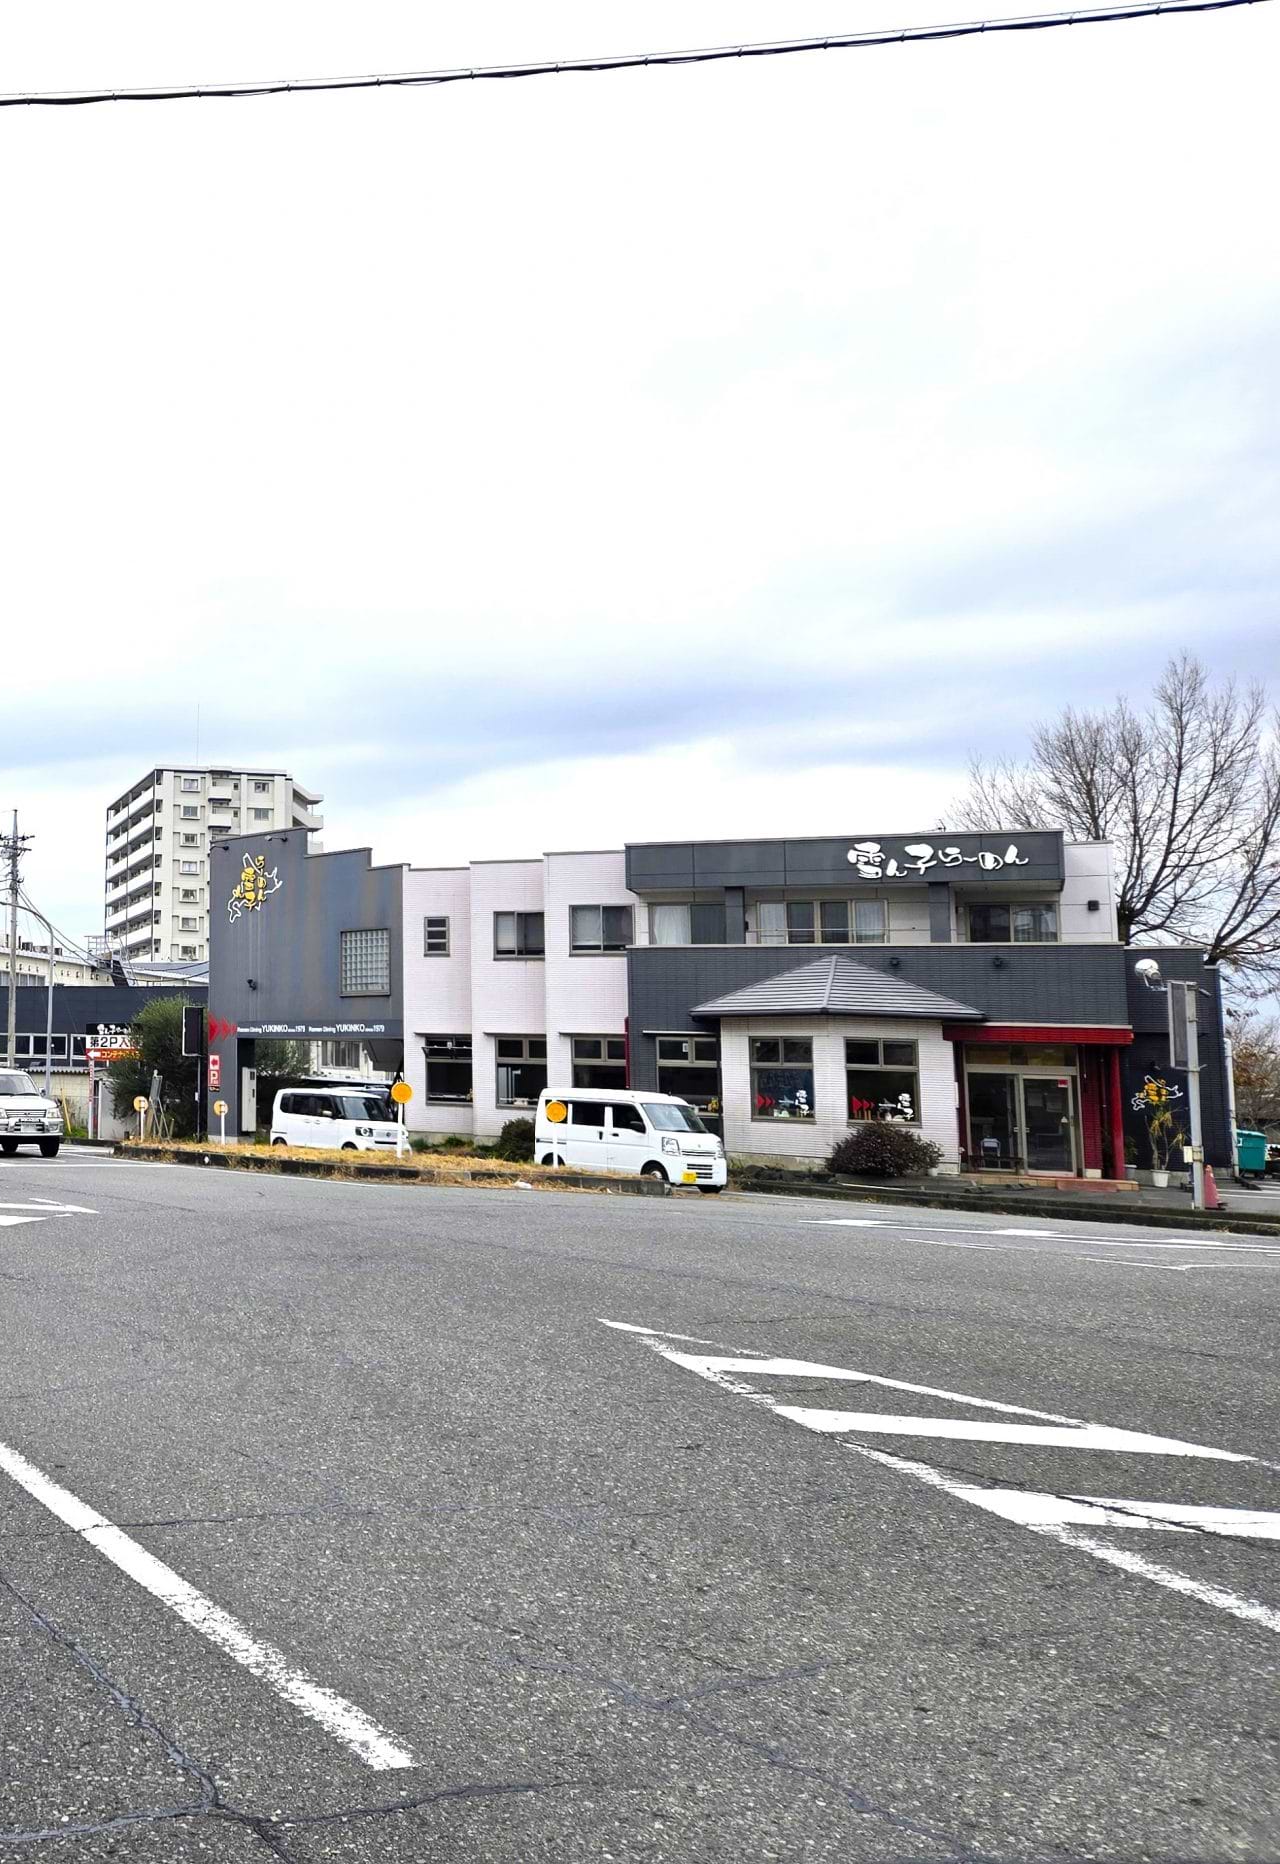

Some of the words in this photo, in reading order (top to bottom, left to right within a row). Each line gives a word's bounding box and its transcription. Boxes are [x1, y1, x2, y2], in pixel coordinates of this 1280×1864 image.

[261, 1024, 288, 1032] YUKINKO
[336, 1024, 365, 1032] YUKINKO
[90, 1036, 135, 1047] 第2P入
